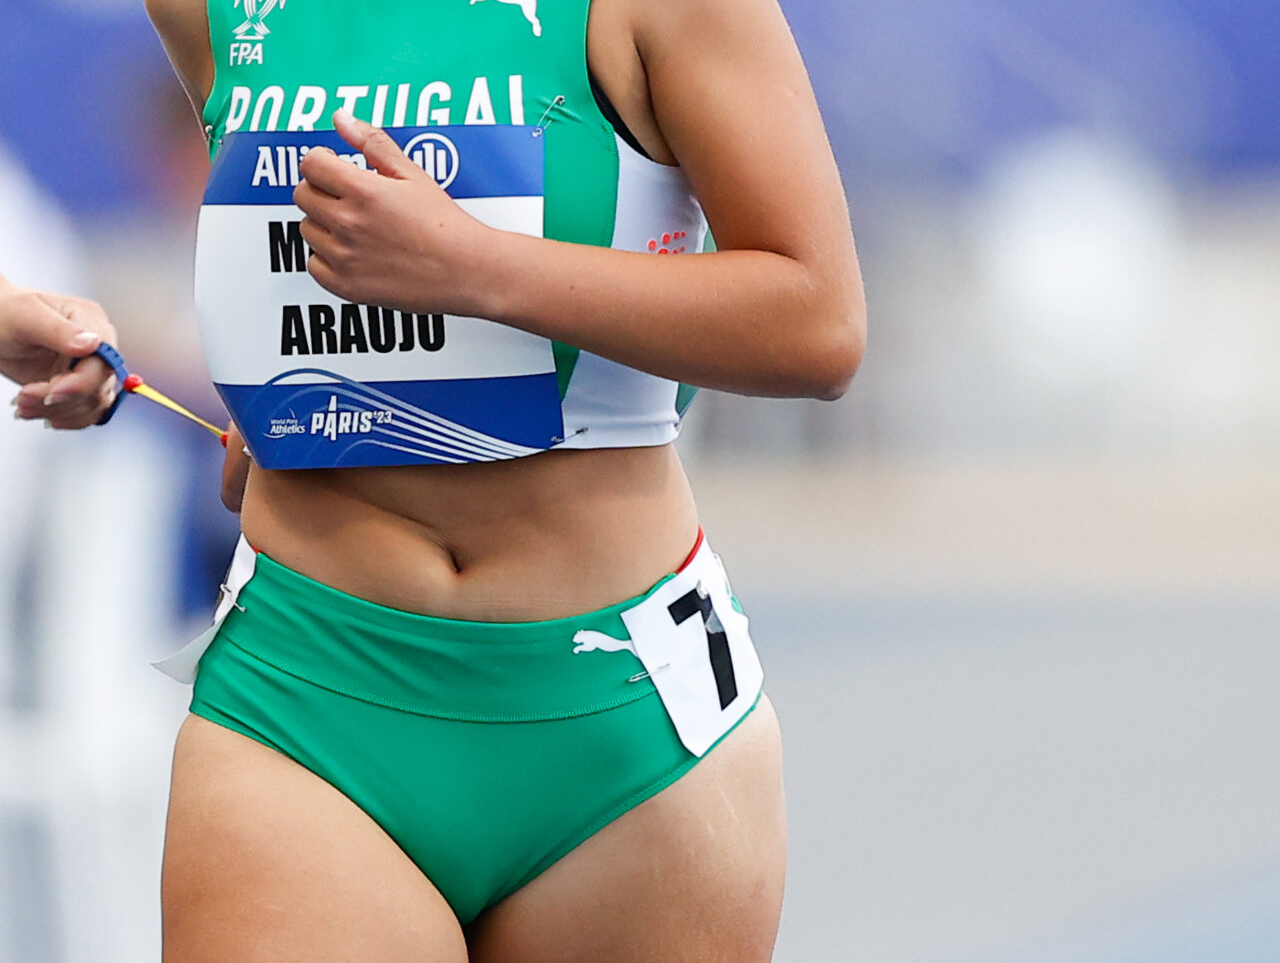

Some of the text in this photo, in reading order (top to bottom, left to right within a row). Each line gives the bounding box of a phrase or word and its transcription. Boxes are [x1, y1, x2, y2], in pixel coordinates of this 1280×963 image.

[229, 42, 264, 67] FPA
[280, 303, 446, 355] ARAUJO
[270, 424, 306, 434] Athletics
